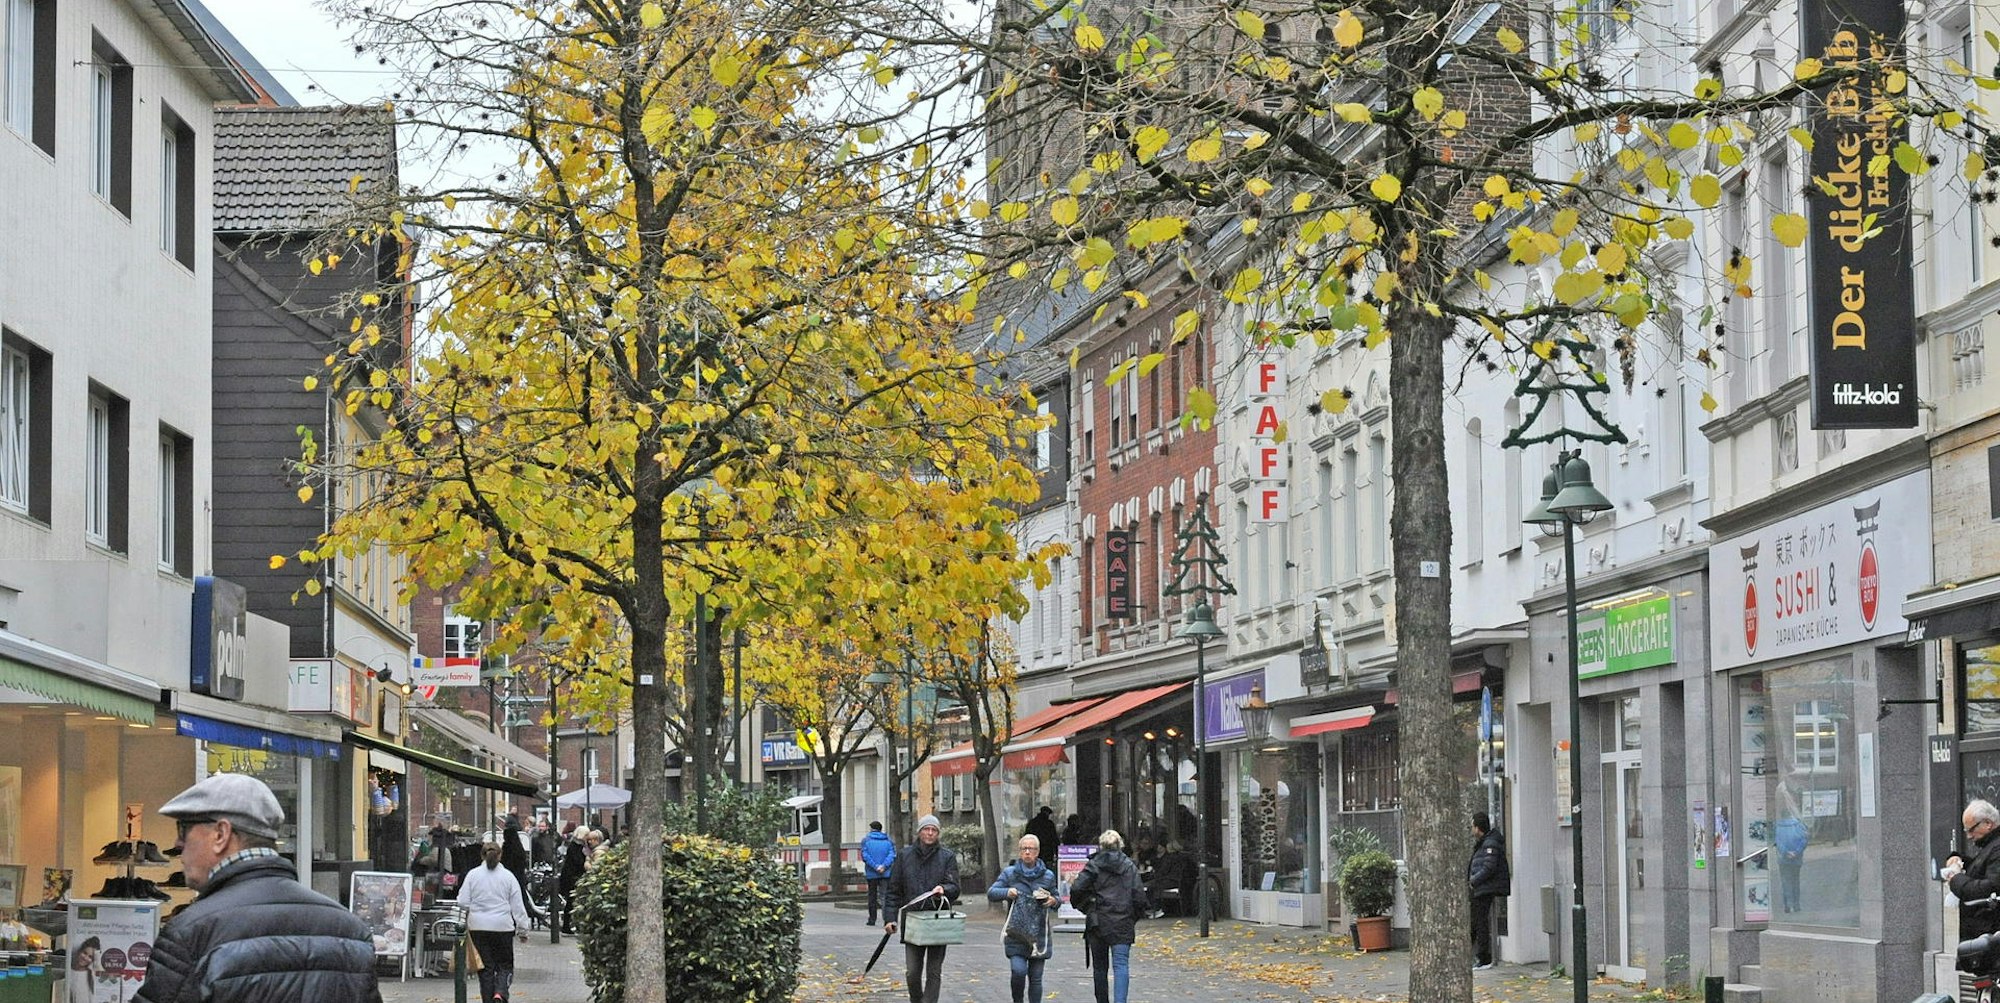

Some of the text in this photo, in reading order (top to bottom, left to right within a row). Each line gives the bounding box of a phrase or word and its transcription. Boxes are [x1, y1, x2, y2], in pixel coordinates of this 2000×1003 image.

[1829, 131, 1864, 254] dicke
[1831, 266, 1867, 350] Der
[1833, 383, 1900, 405] fritz-kola
[1775, 523, 1837, 568] 東京 ボックス
[1108, 537, 1127, 612] CAFE
[1775, 561, 1837, 619] SUSHI &
[1860, 574, 1877, 590] TOKYO
[1863, 589, 1875, 603] BOX
[1609, 607, 1669, 658] HÖRGERÄTE
[1776, 616, 1838, 646] JAPANISCHE KÜCHE
[217, 616, 245, 693] palm
[449, 672, 473, 683] family
[773, 741, 785, 761] VR
